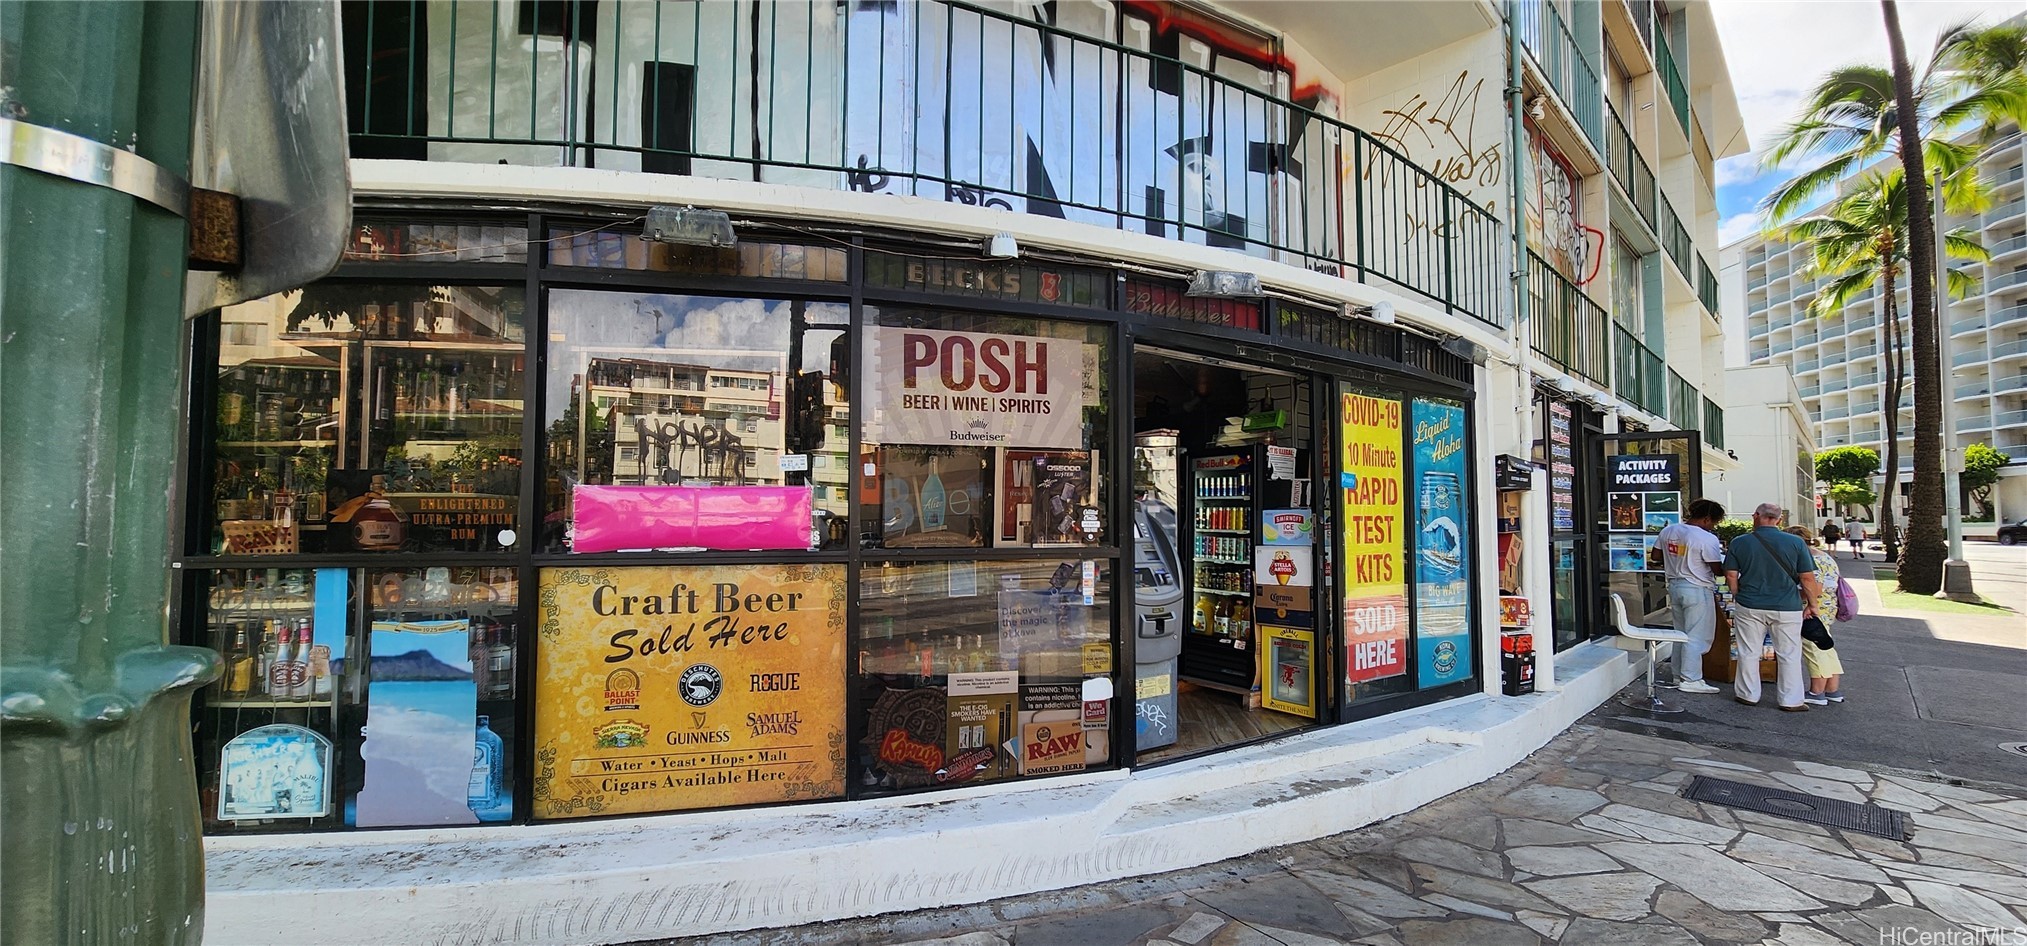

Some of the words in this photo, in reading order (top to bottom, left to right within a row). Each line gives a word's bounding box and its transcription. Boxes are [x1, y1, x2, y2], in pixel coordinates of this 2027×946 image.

[904, 333, 1047, 395] POSH
[903, 394, 940, 410] BEER
[952, 397, 989, 412] WINE
[999, 398, 1051, 415] SPIRITS
[1343, 395, 1399, 429] COVID-19
[950, 430, 1005, 441] Budweiser
[1414, 410, 1450, 445] Liquid
[1348, 442, 1359, 466] 10
[1362, 443, 1397, 469] Minute
[1432, 434, 1462, 463] Aloha
[1618, 460, 1668, 471] ACTIVITY
[1615, 473, 1672, 484] PACKAGES
[1347, 476, 1399, 506] RAPID
[419, 498, 505, 510] ENLIGHTENED
[1275, 515, 1303, 523] SMIRNOFF
[1283, 523, 1294, 531] ICE
[451, 528, 476, 540] RUM
[1353, 515, 1394, 544] TEST
[1356, 553, 1393, 584] KITS
[1428, 585, 1441, 597] BIG
[1442, 583, 1461, 597] WAVE
[592, 583, 700, 616] Craft
[711, 582, 804, 613] Beer
[1002, 606, 1042, 616] Discover
[1002, 619, 1018, 628] the
[1020, 616, 1048, 627] magic
[1354, 605, 1396, 636] SOLD
[604, 622, 695, 664] Sold
[703, 615, 788, 649] Here
[1355, 638, 1397, 671] HERE
[681, 666, 720, 683] DESCHUTES
[749, 672, 800, 692] ROGUE
[604, 691, 640, 699] BALLAST
[1025, 694, 1051, 702] contains
[1028, 686, 1060, 694] WARNING:
[684, 695, 715, 705] BREWERY
[1088, 702, 1103, 710] We
[746, 711, 802, 727] SAMUEL
[951, 710, 980, 718] SMOKERS
[1085, 707, 1106, 717] Card
[666, 730, 730, 746] GUINNESS
[750, 722, 798, 739] ADAMS
[1027, 731, 1082, 761] RAW
[600, 760, 643, 772] Water
[660, 757, 697, 768] Yeast
[710, 754, 745, 767] Hops
[757, 751, 788, 763] Malt
[1026, 765, 1060, 775] SMOKED
[1061, 763, 1084, 771] HERE
[601, 777, 657, 794] Cigars
[661, 770, 742, 788] Available
[746, 768, 786, 782] Here
